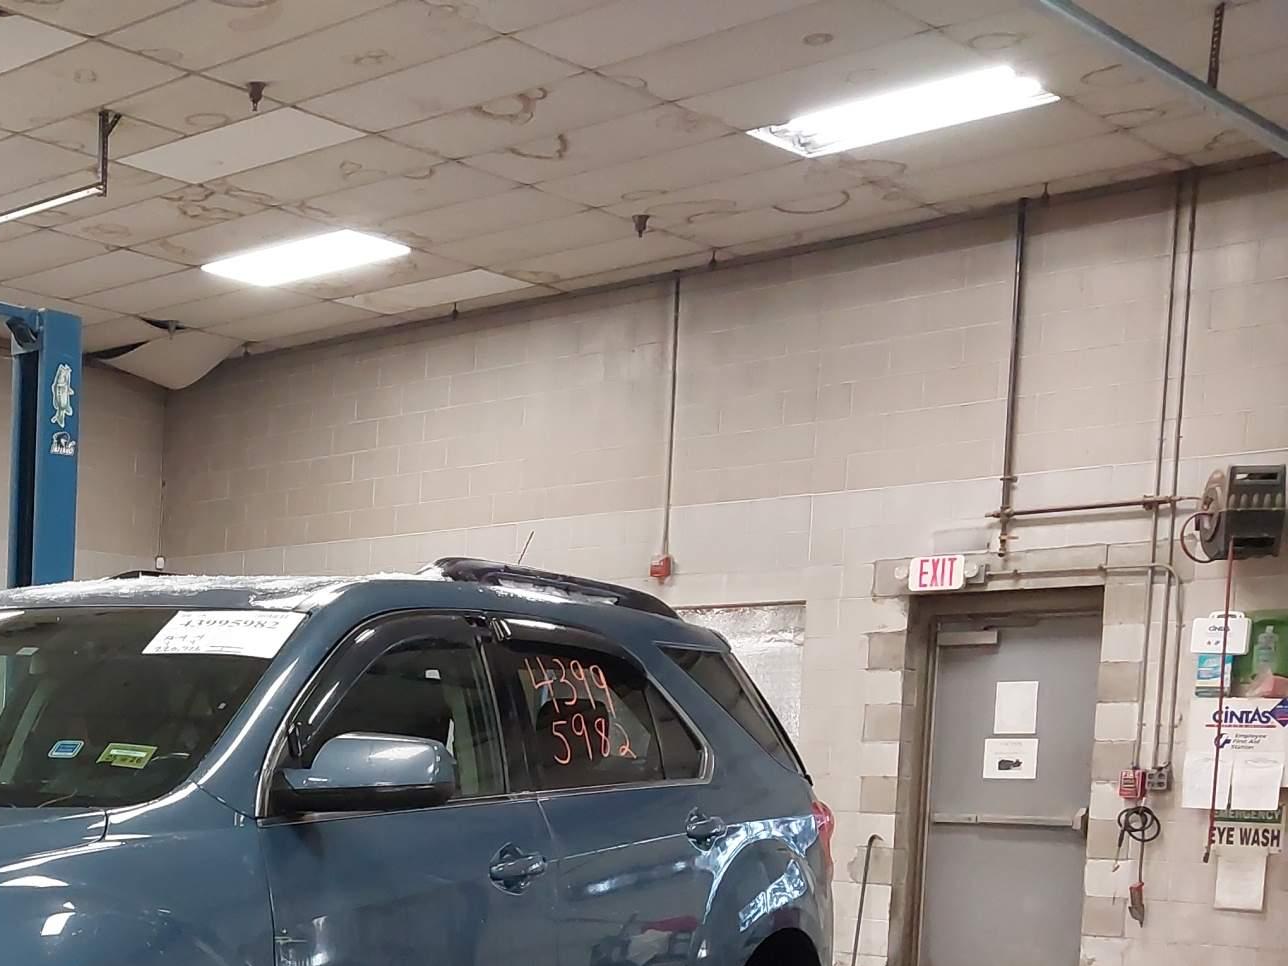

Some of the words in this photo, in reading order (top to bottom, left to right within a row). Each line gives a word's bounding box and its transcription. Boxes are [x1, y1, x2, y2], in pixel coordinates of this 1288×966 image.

[918, 557, 958, 588] EXIT
[524, 656, 617, 719] 4399
[552, 713, 638, 765] 5982
[1209, 826, 1235, 845] EYE
[1239, 827, 1281, 848] WASH
